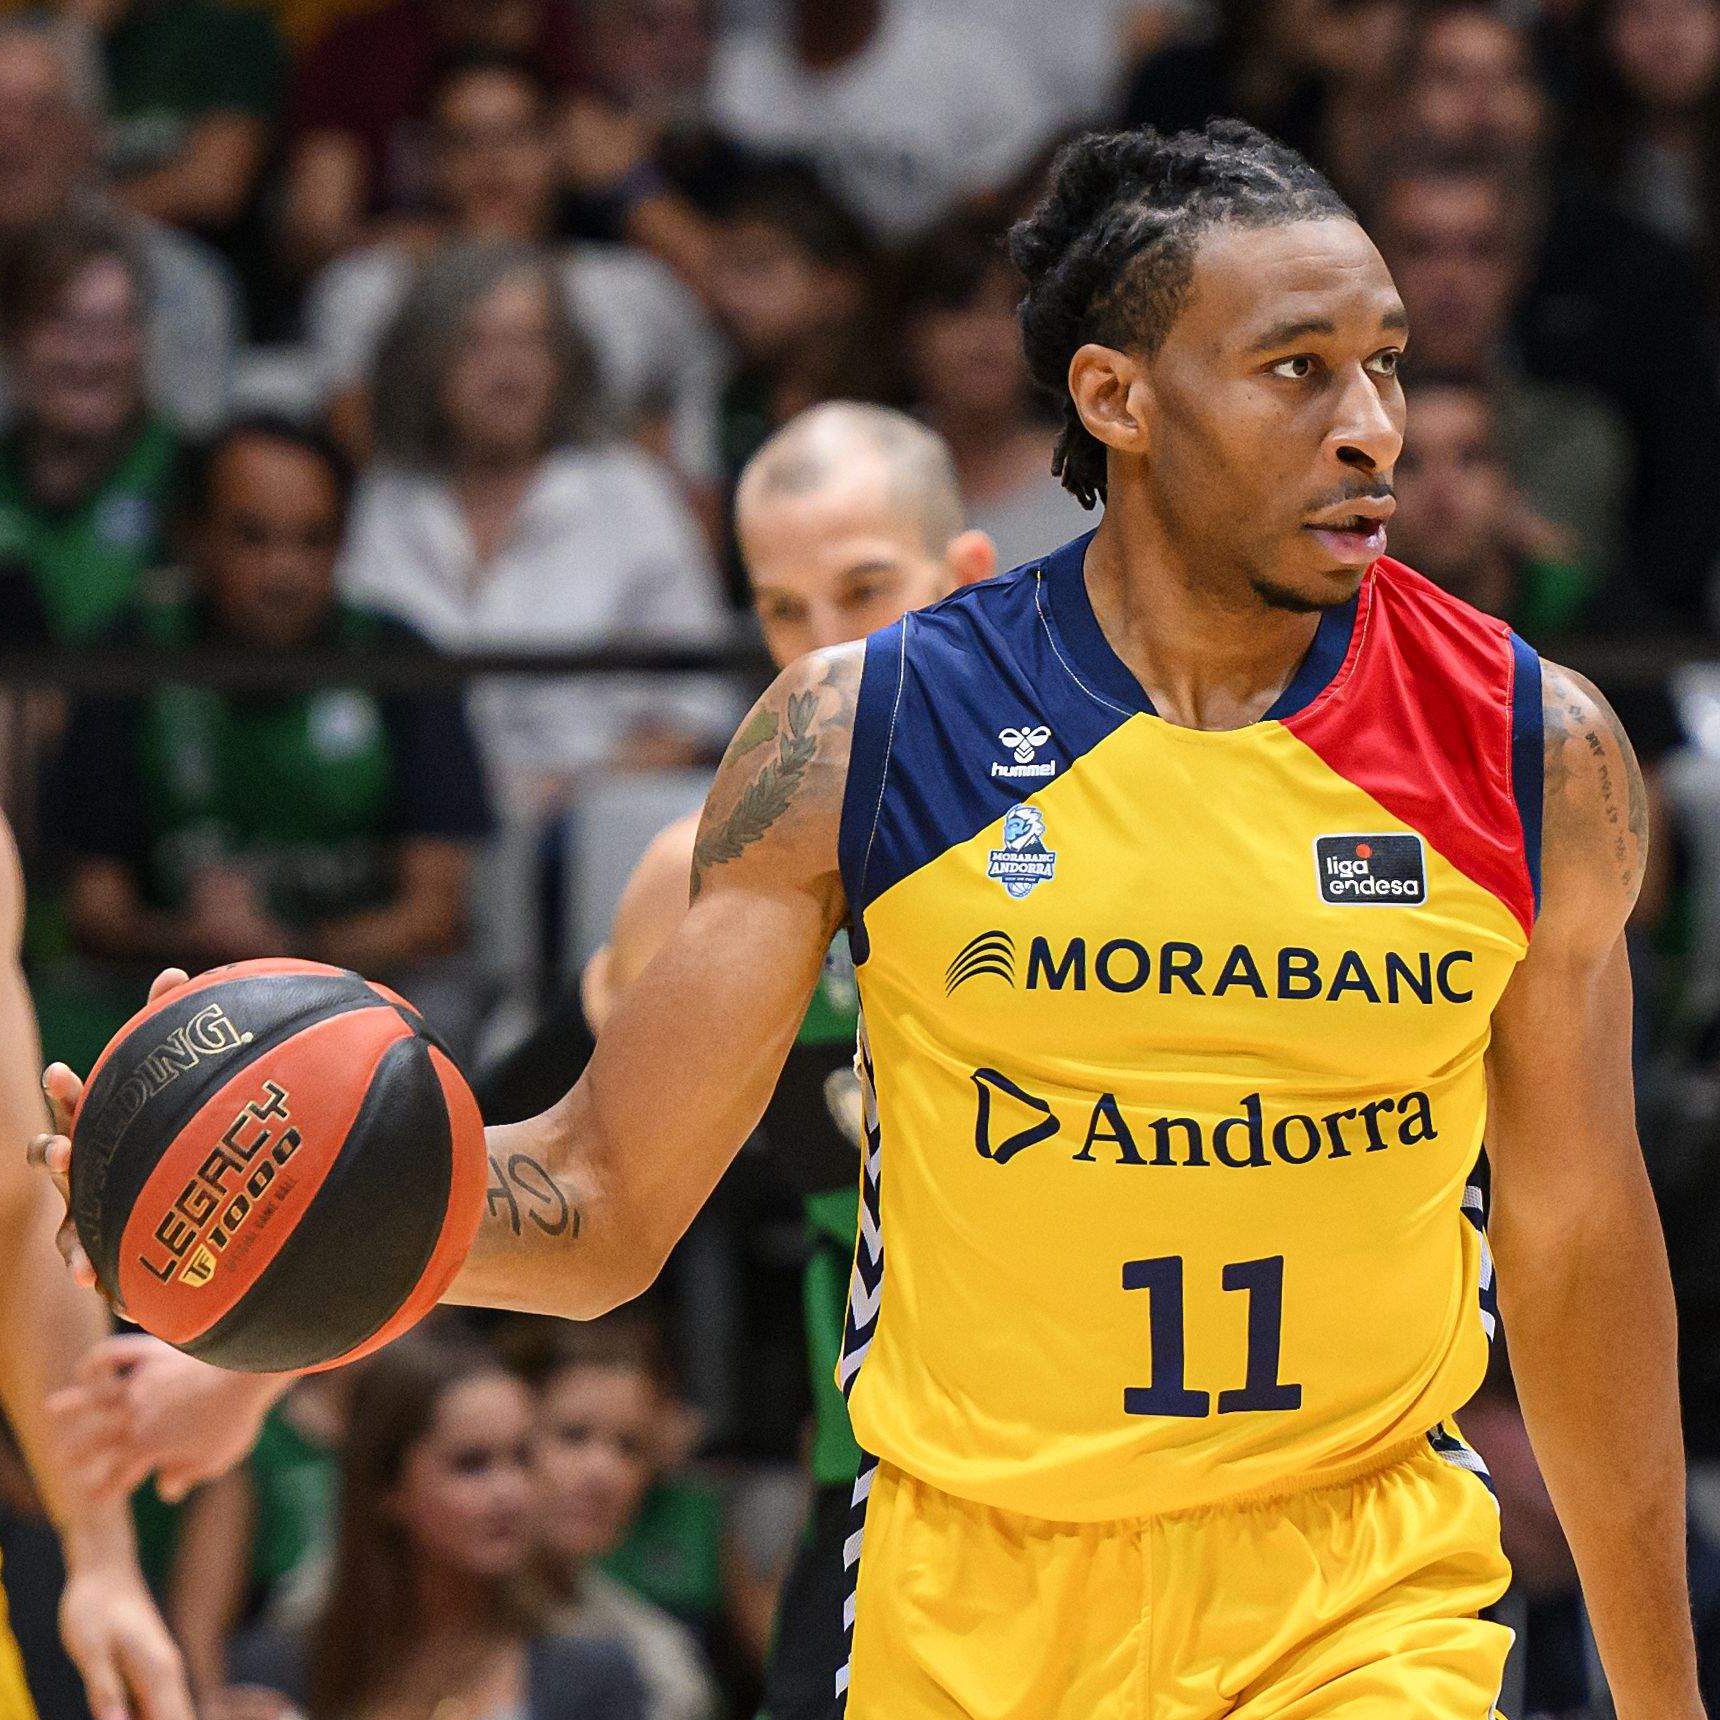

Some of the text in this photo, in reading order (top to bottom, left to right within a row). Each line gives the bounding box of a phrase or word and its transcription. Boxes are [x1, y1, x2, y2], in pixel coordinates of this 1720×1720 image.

[991, 760, 1056, 777] hummel
[990, 862, 1053, 876] ANDORRA
[992, 853, 1054, 862] MORABANC
[1326, 856, 1369, 878] liga
[1329, 875, 1419, 895] endesa
[1025, 936, 1474, 1004] MORABANC
[1072, 1089, 1438, 1168] Andorra
[137, 1079, 290, 1284] LEGACY
[207, 1125, 301, 1250] 1000
[1122, 1255, 1302, 1417] 11
